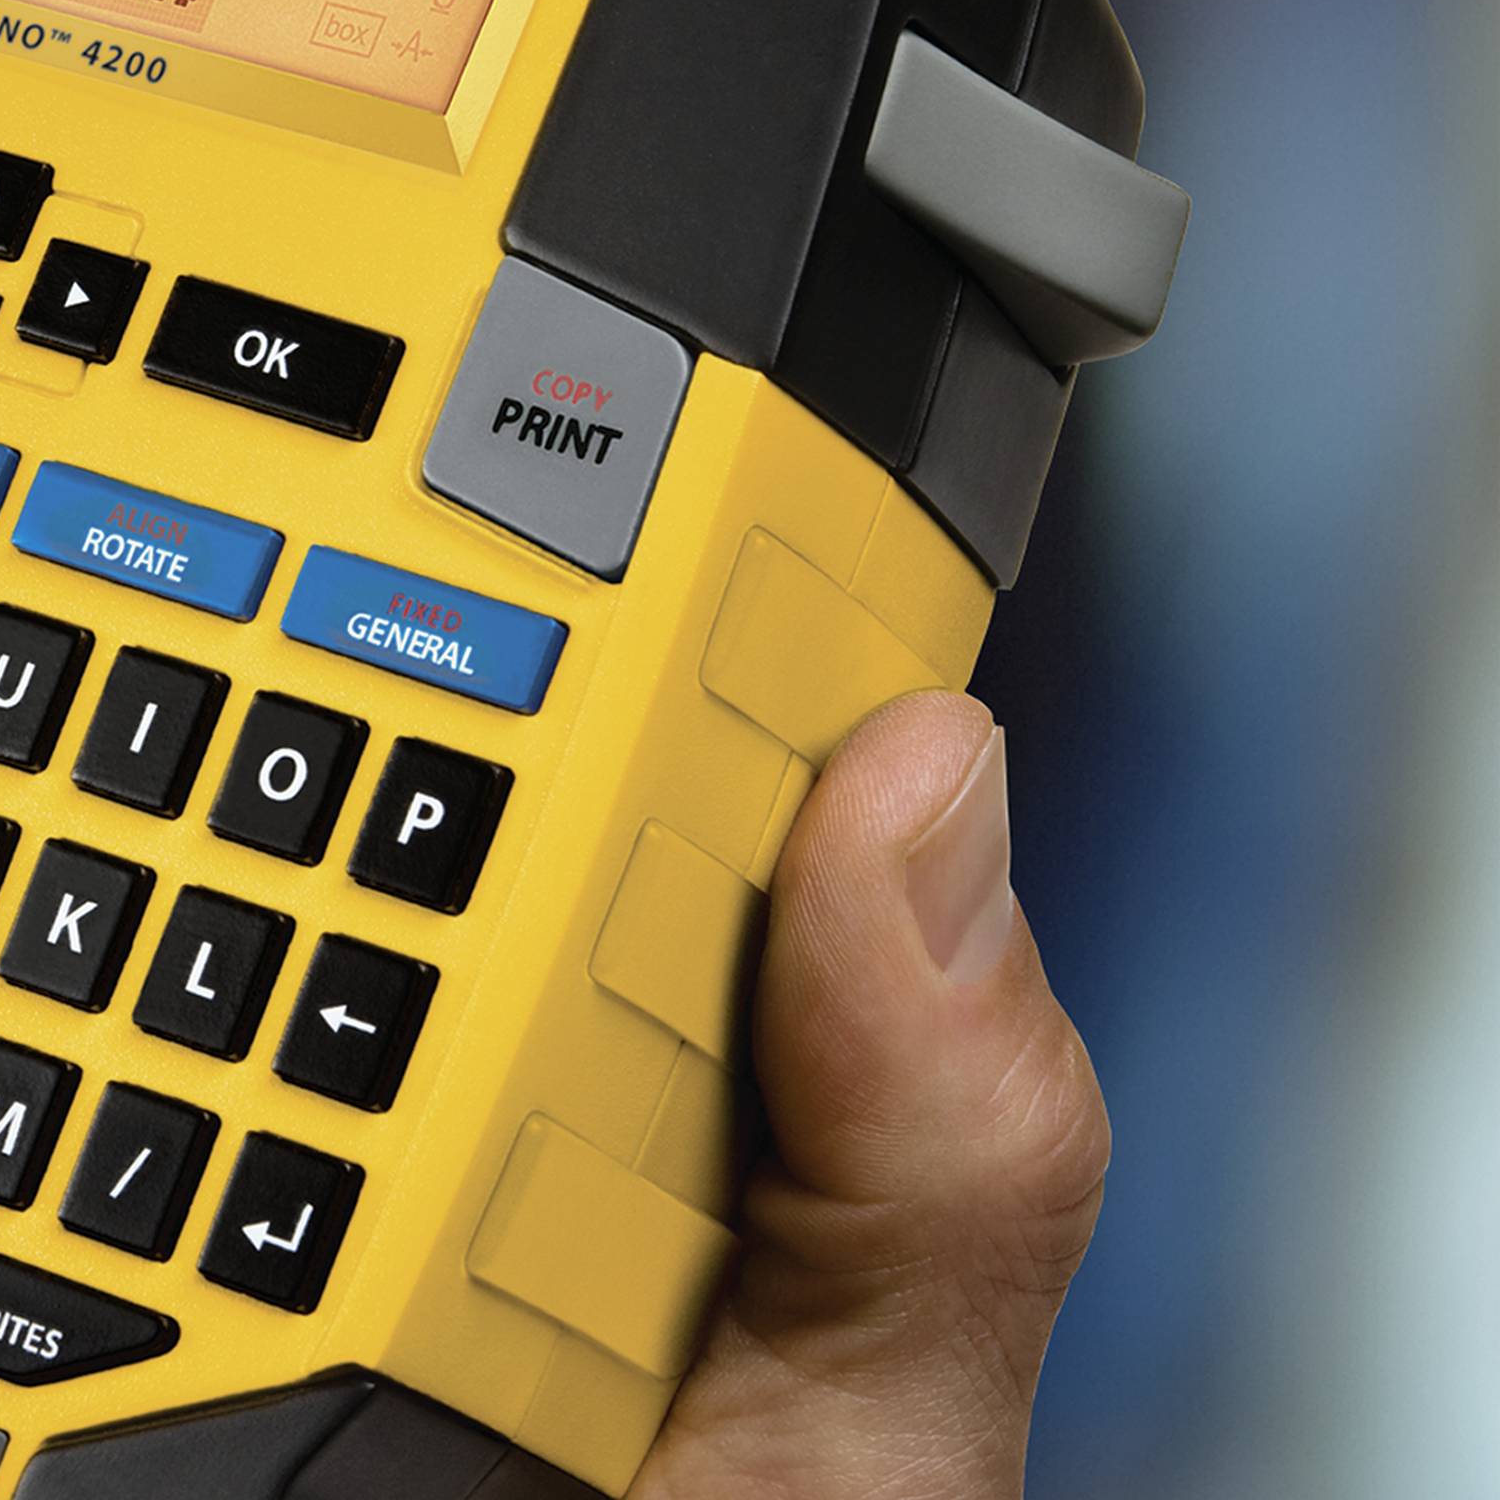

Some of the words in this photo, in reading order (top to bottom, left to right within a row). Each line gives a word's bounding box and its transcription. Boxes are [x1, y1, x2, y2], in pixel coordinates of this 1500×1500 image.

[323, 13, 370, 46] box
[81, 40, 167, 83] 4200
[233, 329, 299, 379] OK
[531, 369, 613, 411] COPY
[490, 396, 624, 467] PRINT
[106, 503, 189, 546] ALIGN
[81, 527, 190, 583] ROTATE
[388, 592, 463, 634] FIXED
[346, 612, 474, 676] GENERAL
[130, 702, 158, 753] I
[259, 748, 307, 801] O
[397, 792, 444, 844] P
[47, 893, 98, 953] K
[185, 941, 215, 999] L
[109, 1148, 151, 1198] /
